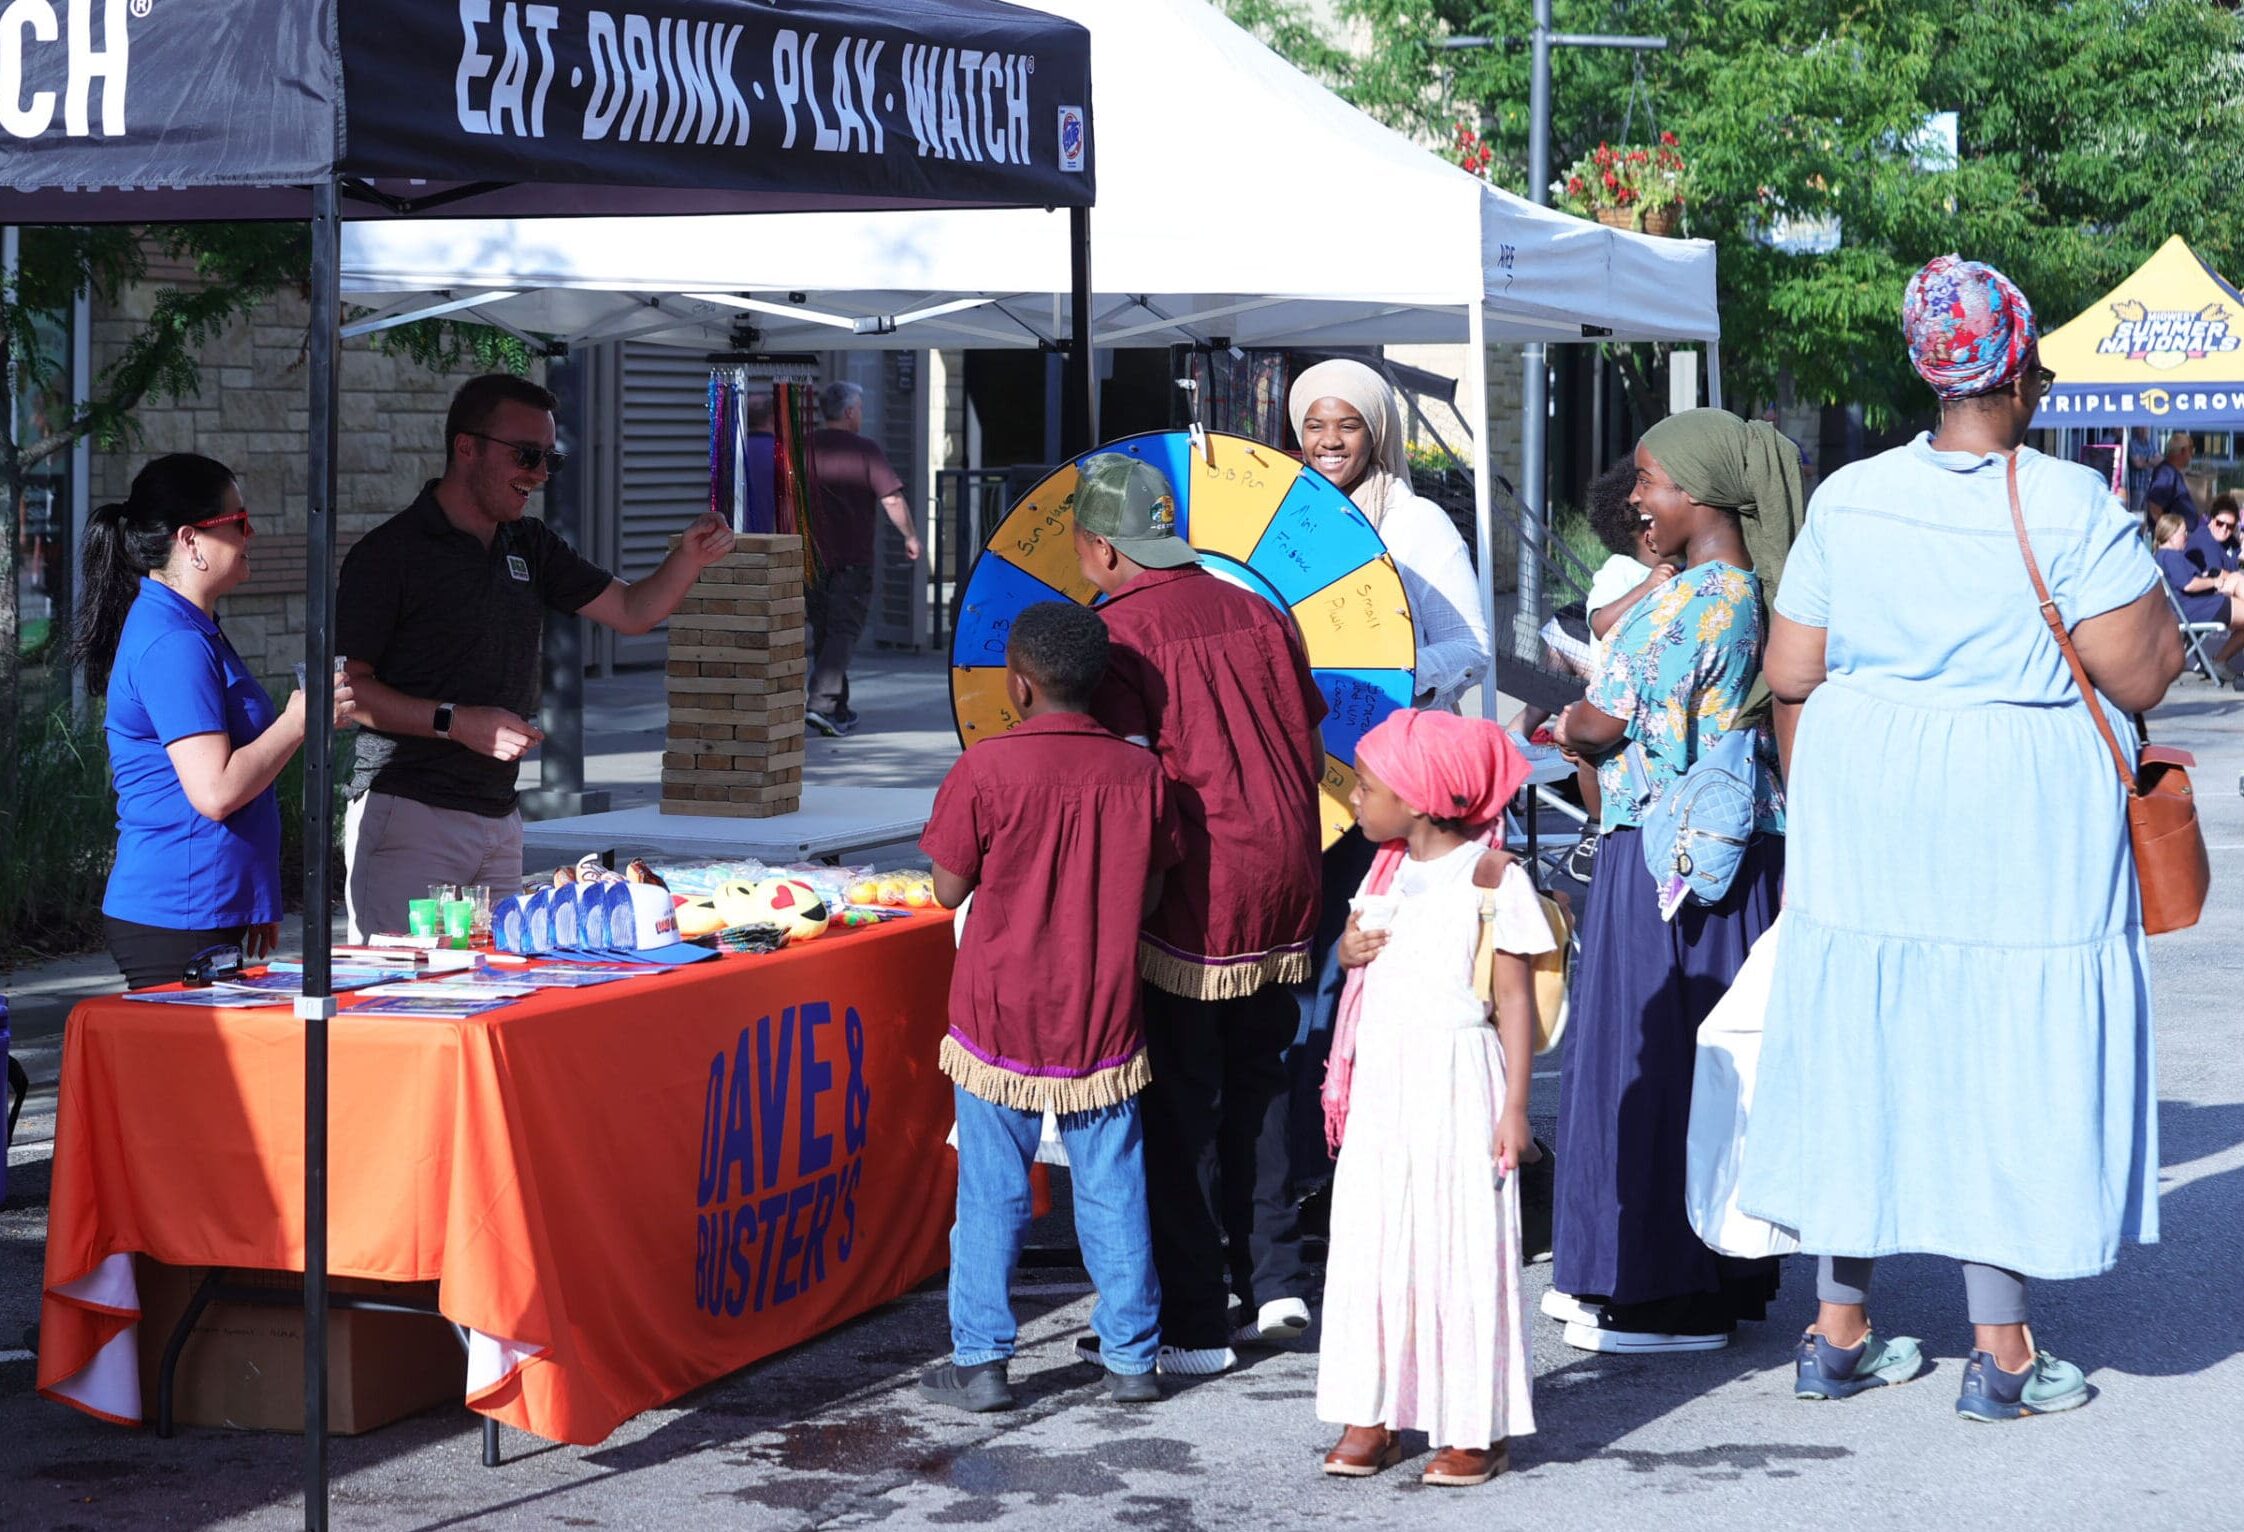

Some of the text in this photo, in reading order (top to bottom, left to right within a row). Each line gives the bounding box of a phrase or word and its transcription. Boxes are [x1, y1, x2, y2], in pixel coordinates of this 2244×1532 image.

[456, 0, 558, 137] EAT
[583, 12, 752, 146] DRINK
[772, 29, 886, 155] PLAY
[2097, 336, 2241, 354] NATIONALS
[2115, 320, 2229, 338] SUMMER
[2039, 393, 2134, 413] TRIPLE
[697, 1001, 871, 1208] DAVE &
[695, 1155, 862, 1318] BUSTER'S
